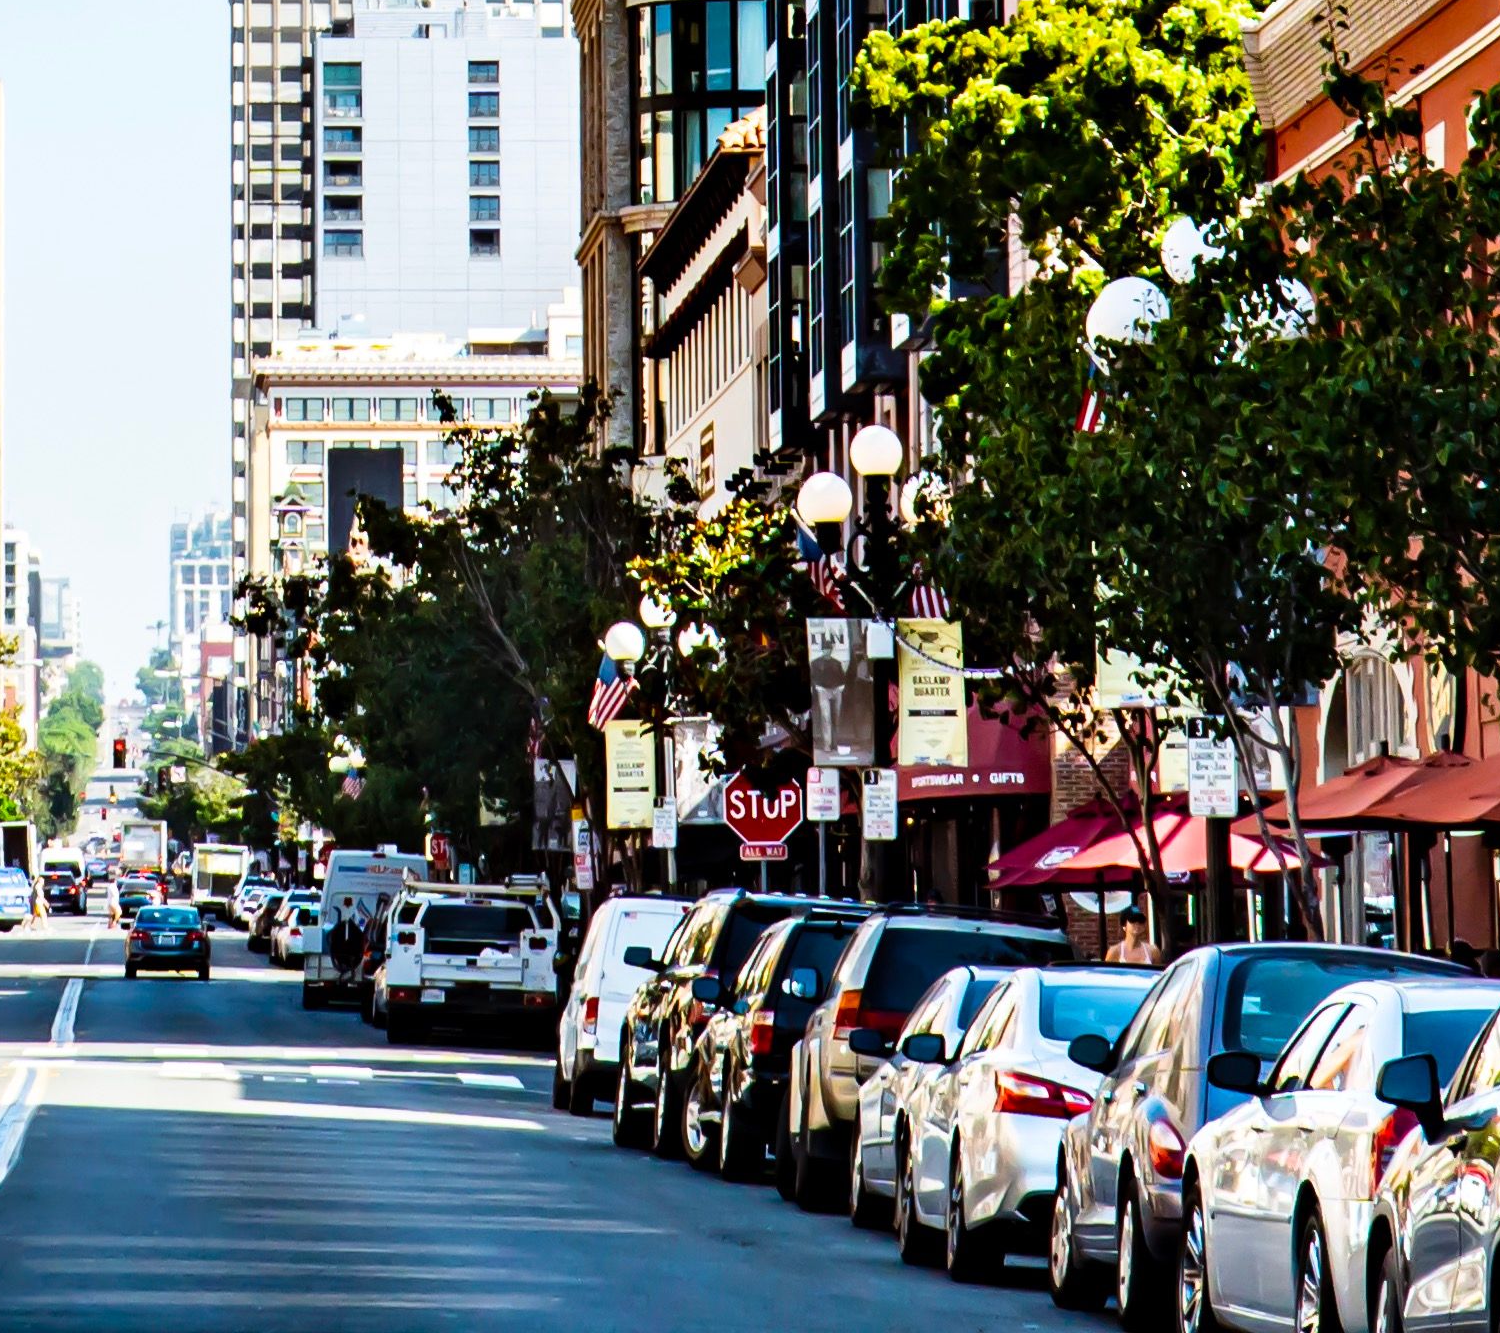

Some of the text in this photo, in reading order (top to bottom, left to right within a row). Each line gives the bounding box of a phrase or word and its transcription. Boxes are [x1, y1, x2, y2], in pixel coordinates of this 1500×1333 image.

[912, 675, 951, 685] GASLAMP
[913, 686, 951, 697] QUARTER
[989, 772, 1025, 784] GIFTS
[729, 789, 797, 820] STOP
[743, 845, 785, 858] ALL WAY
